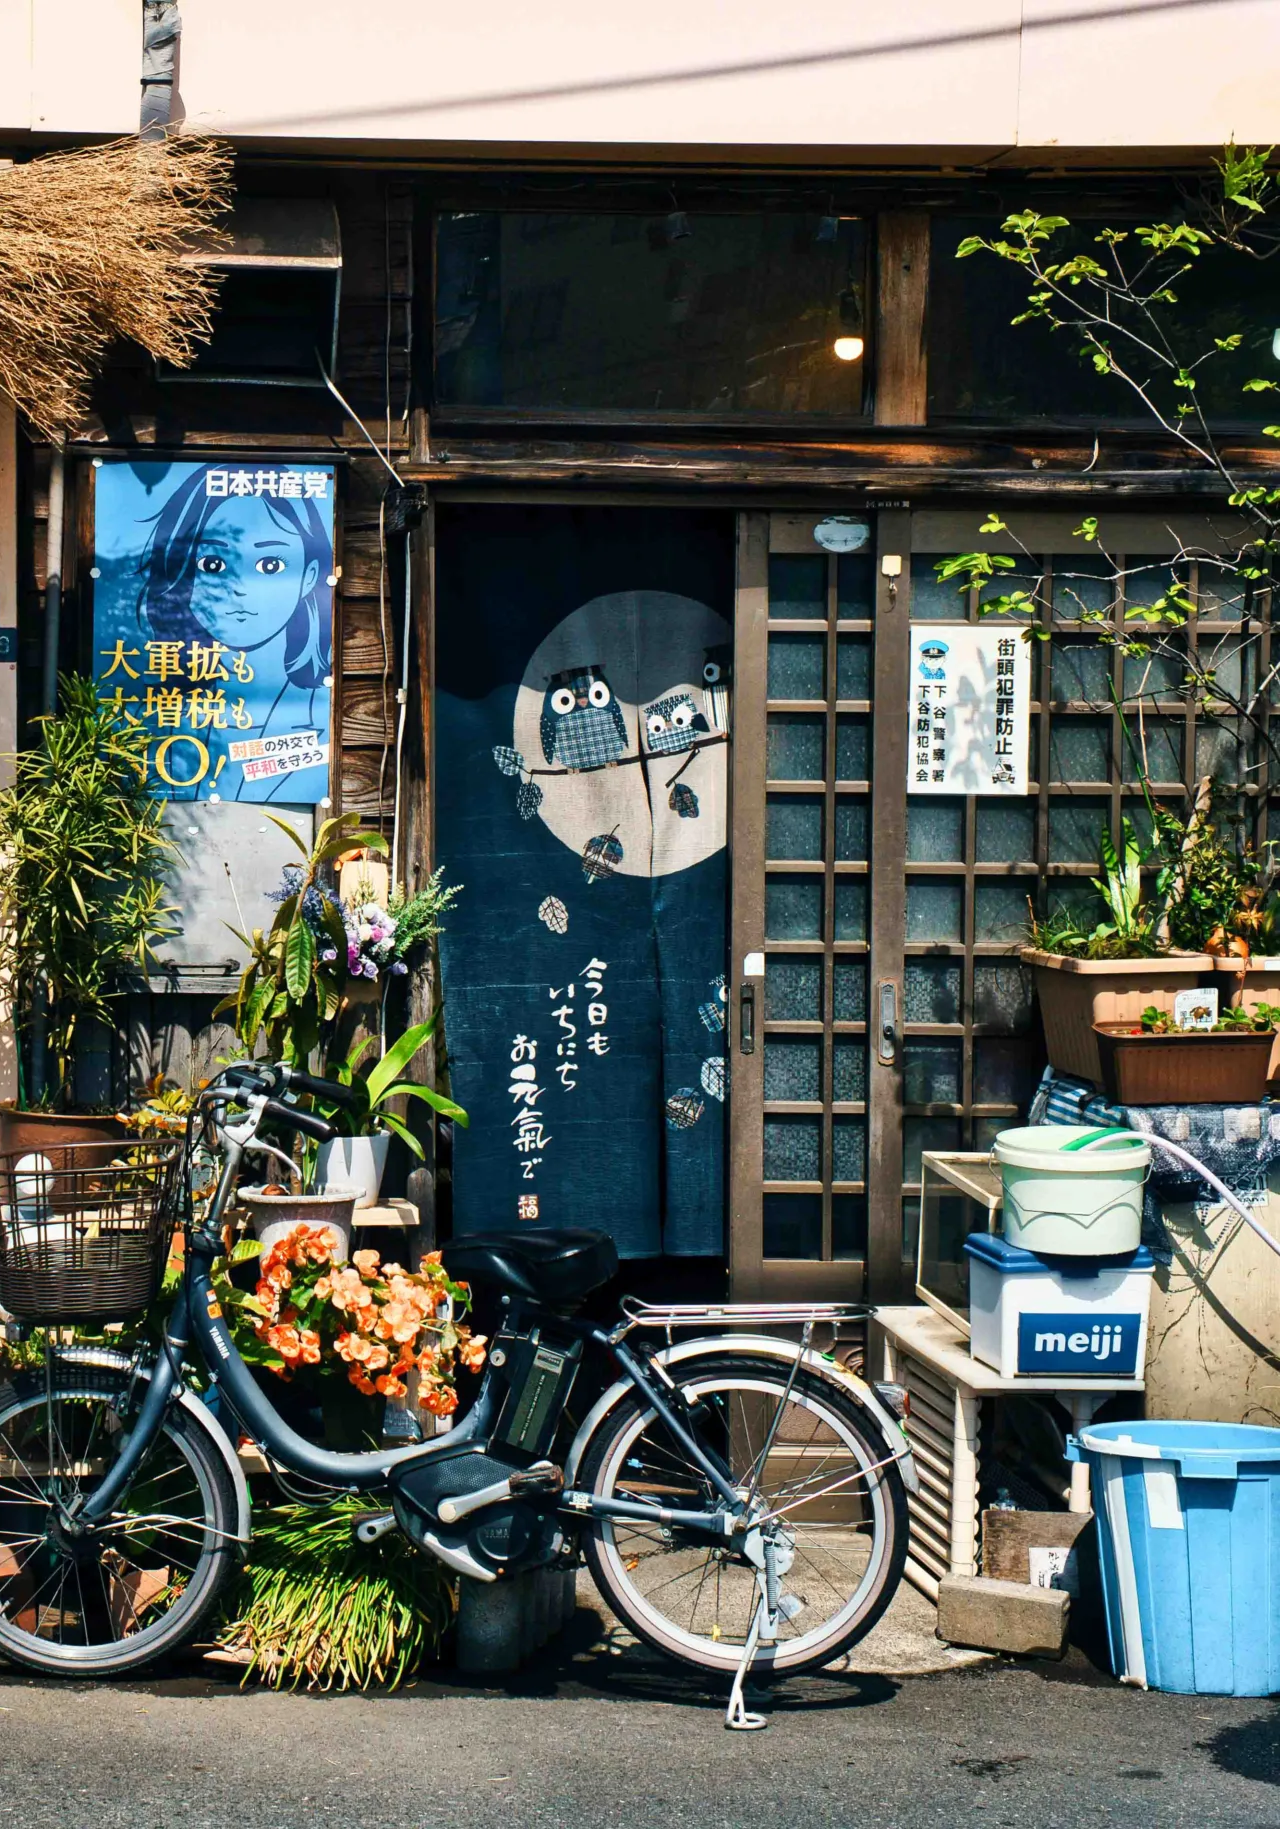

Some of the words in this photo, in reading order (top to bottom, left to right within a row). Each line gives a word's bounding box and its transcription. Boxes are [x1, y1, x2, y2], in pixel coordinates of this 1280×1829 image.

[206, 470, 328, 498] 日本共産党
[100, 639, 255, 683] 大軍拡も
[98, 686, 253, 730] 大増税も
[995, 638, 1016, 755] 街頭犯罪防止
[231, 735, 314, 759] 対話の外交で
[916, 685, 931, 782] 下谷防犯協会
[932, 685, 947, 783] 下谷警察署
[245, 750, 324, 779] 平和を守ろう
[578, 958, 611, 1056] 今日も
[549, 984, 578, 1092] いちにち
[209, 1325, 231, 1360] YAMAHA
[1034, 1325, 1123, 1360] meiji
